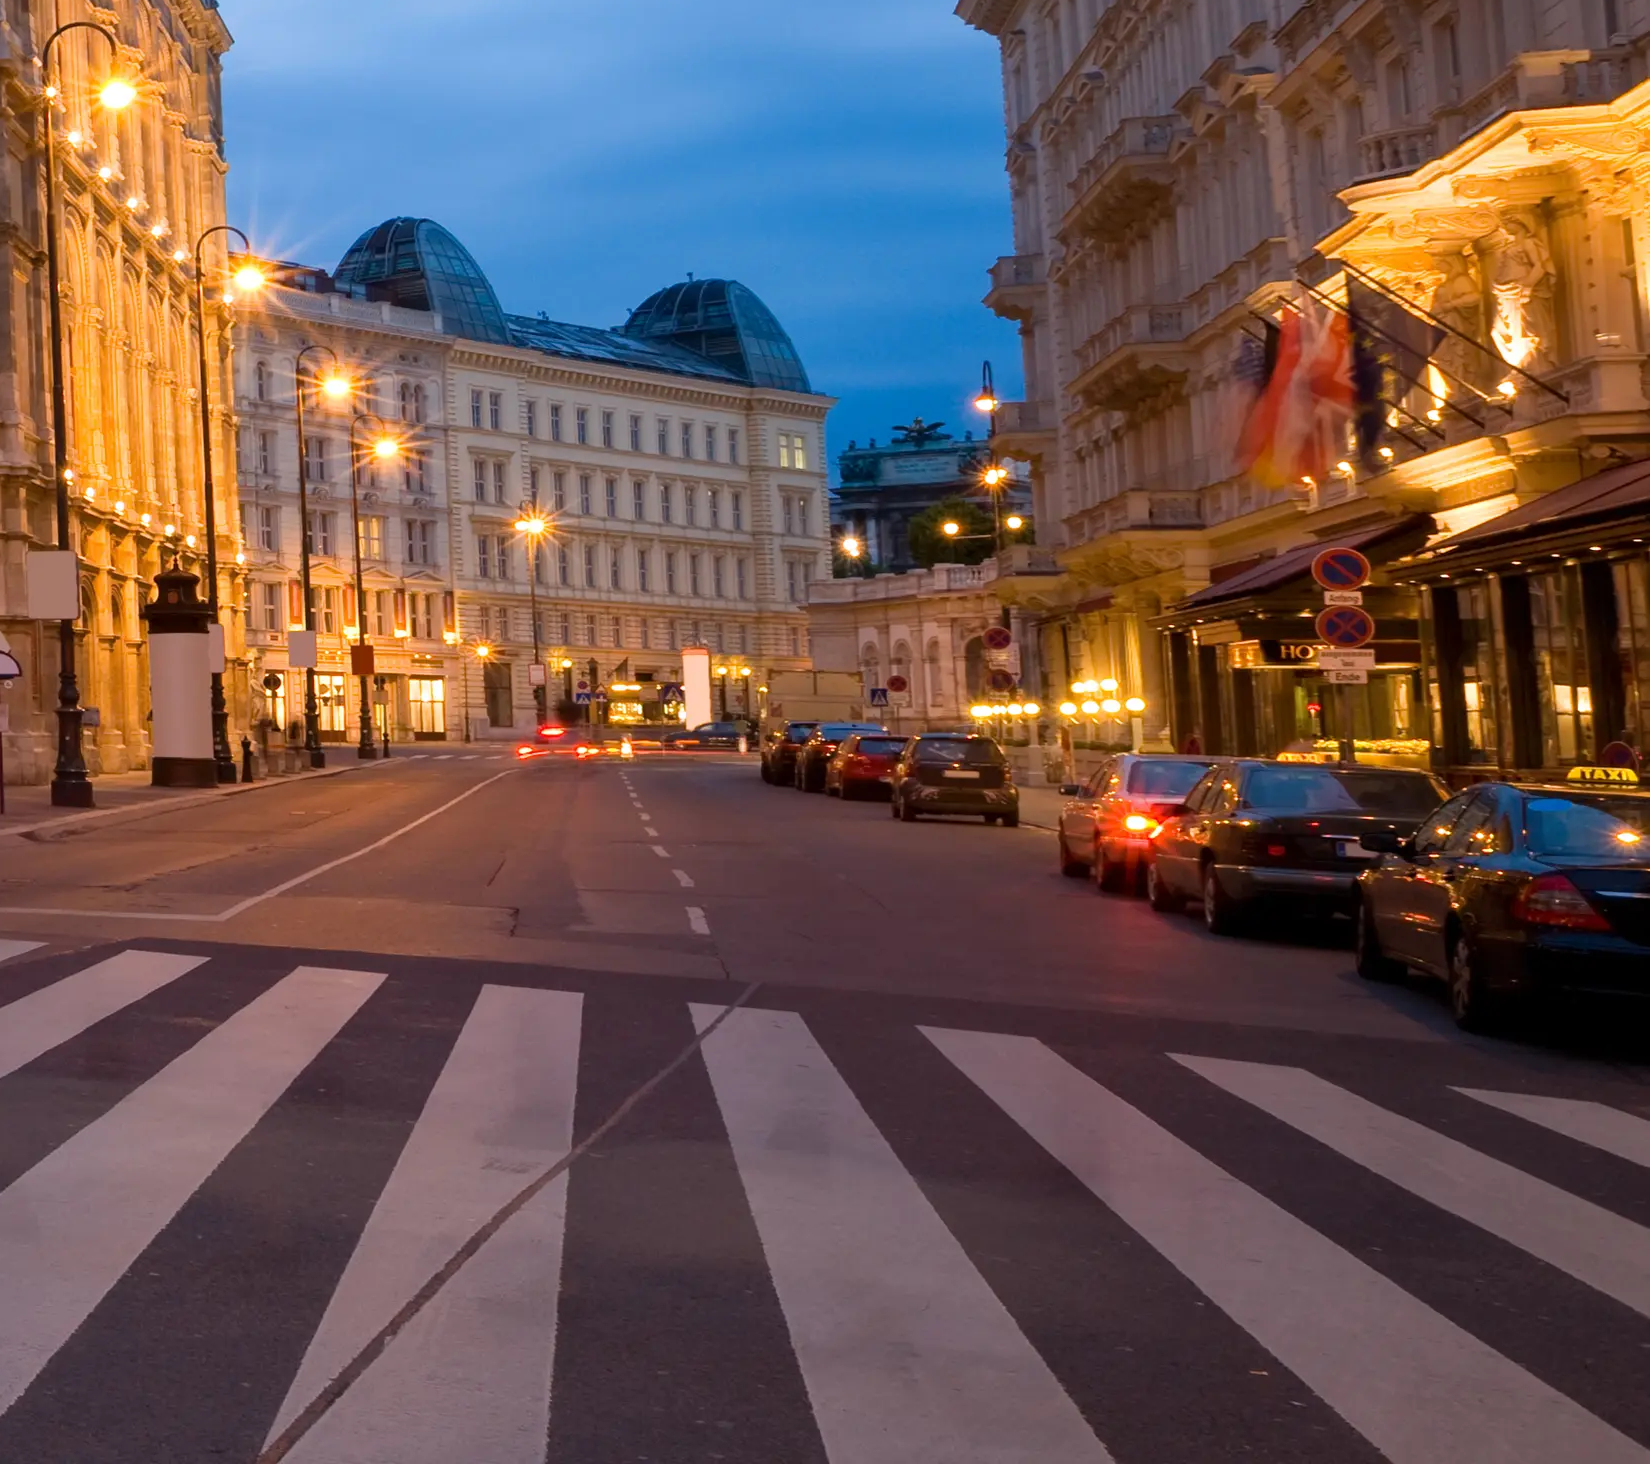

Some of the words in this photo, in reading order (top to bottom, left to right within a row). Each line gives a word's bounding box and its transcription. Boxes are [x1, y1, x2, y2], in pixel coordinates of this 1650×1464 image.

[1280, 644, 1335, 659] HOT
[1335, 672, 1360, 681] Ende
[1581, 768, 1627, 781] TAXI
